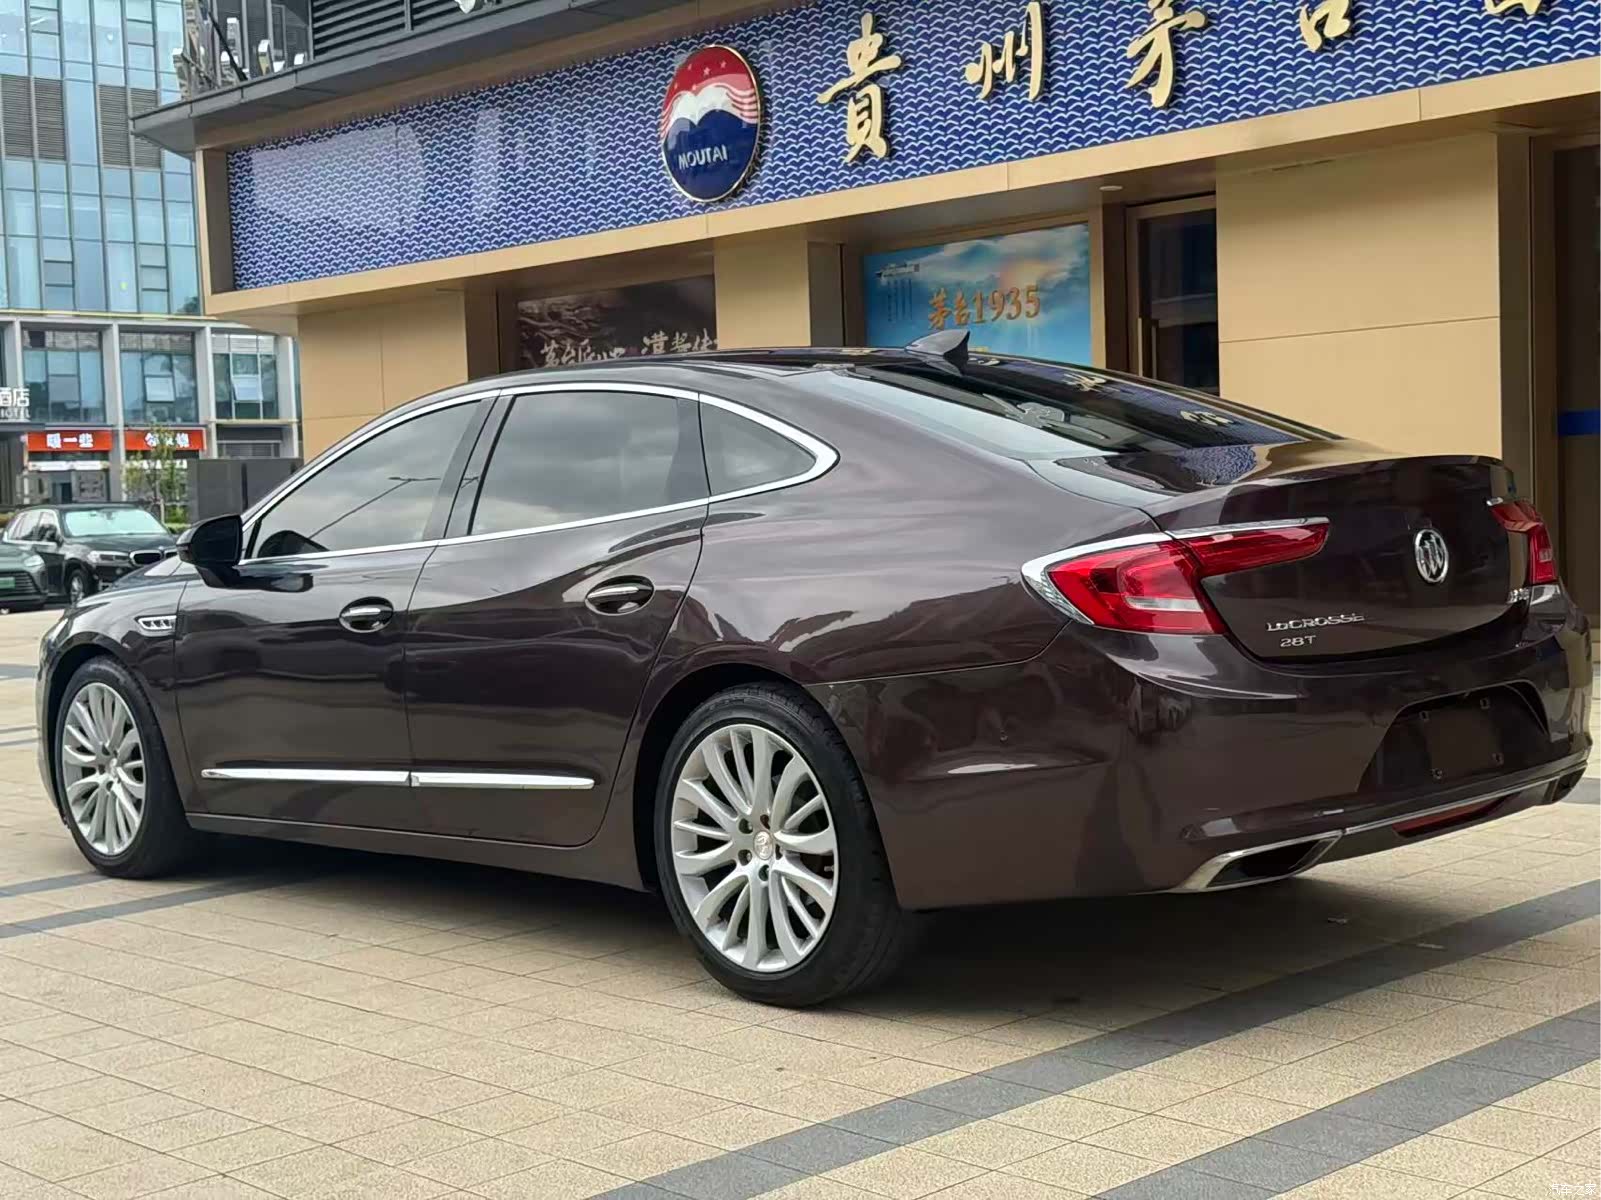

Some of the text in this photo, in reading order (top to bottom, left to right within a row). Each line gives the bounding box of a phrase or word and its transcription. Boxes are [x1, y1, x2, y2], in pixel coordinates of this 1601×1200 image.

[678, 144, 728, 170] MOUTAI
[928, 285, 1041, 330] 茅台1935
[1280, 635, 1316, 648] 28T
